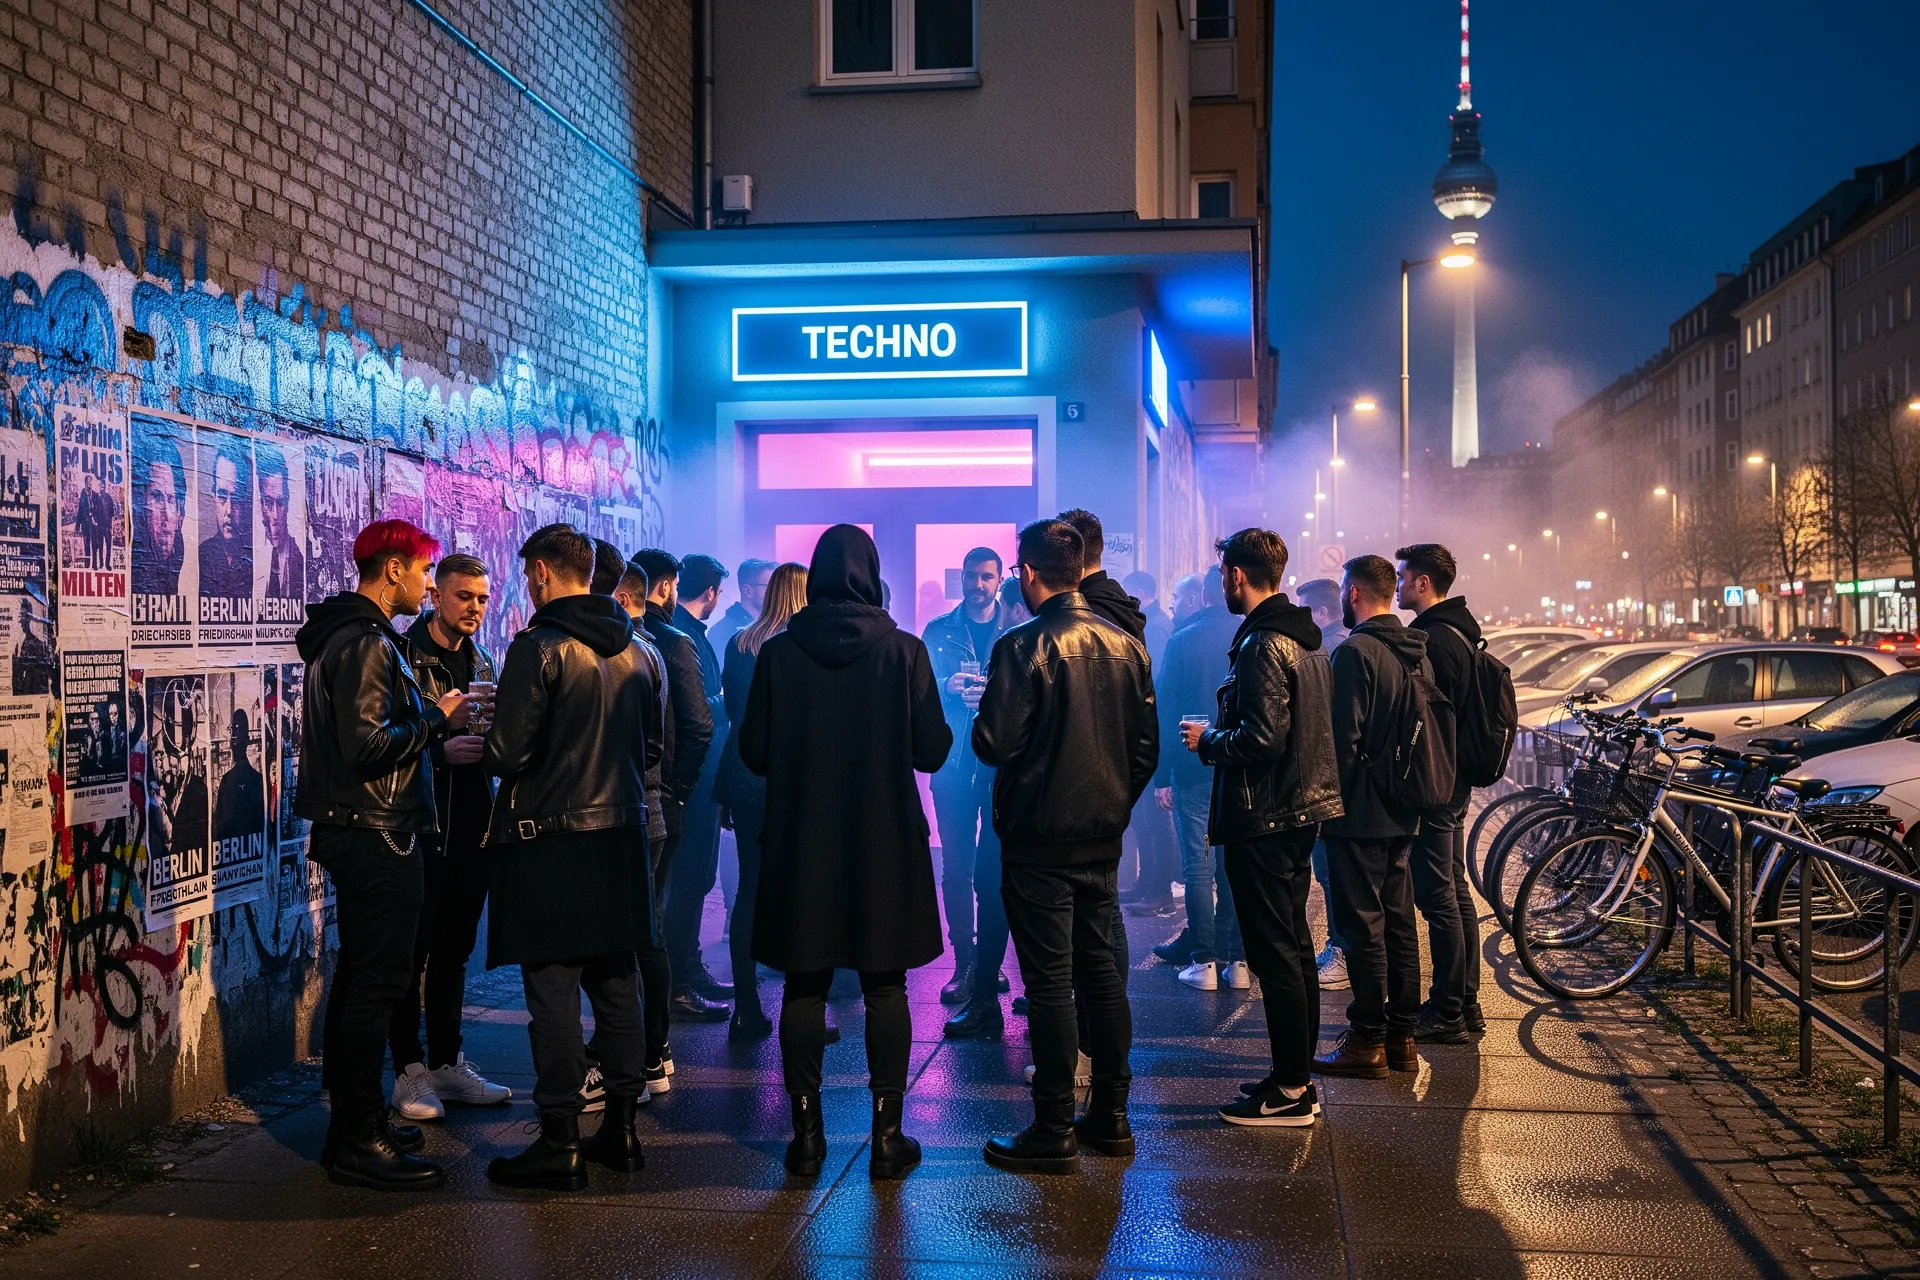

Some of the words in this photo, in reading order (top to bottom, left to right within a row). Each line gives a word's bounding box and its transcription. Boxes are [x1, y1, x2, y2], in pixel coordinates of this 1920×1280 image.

[802, 322, 957, 360] TECHNO
[62, 570, 126, 598] MILTEN
[200, 596, 252, 622] BERLIN
[153, 847, 203, 887] BERLIN
[212, 832, 262, 867] BERLIN
